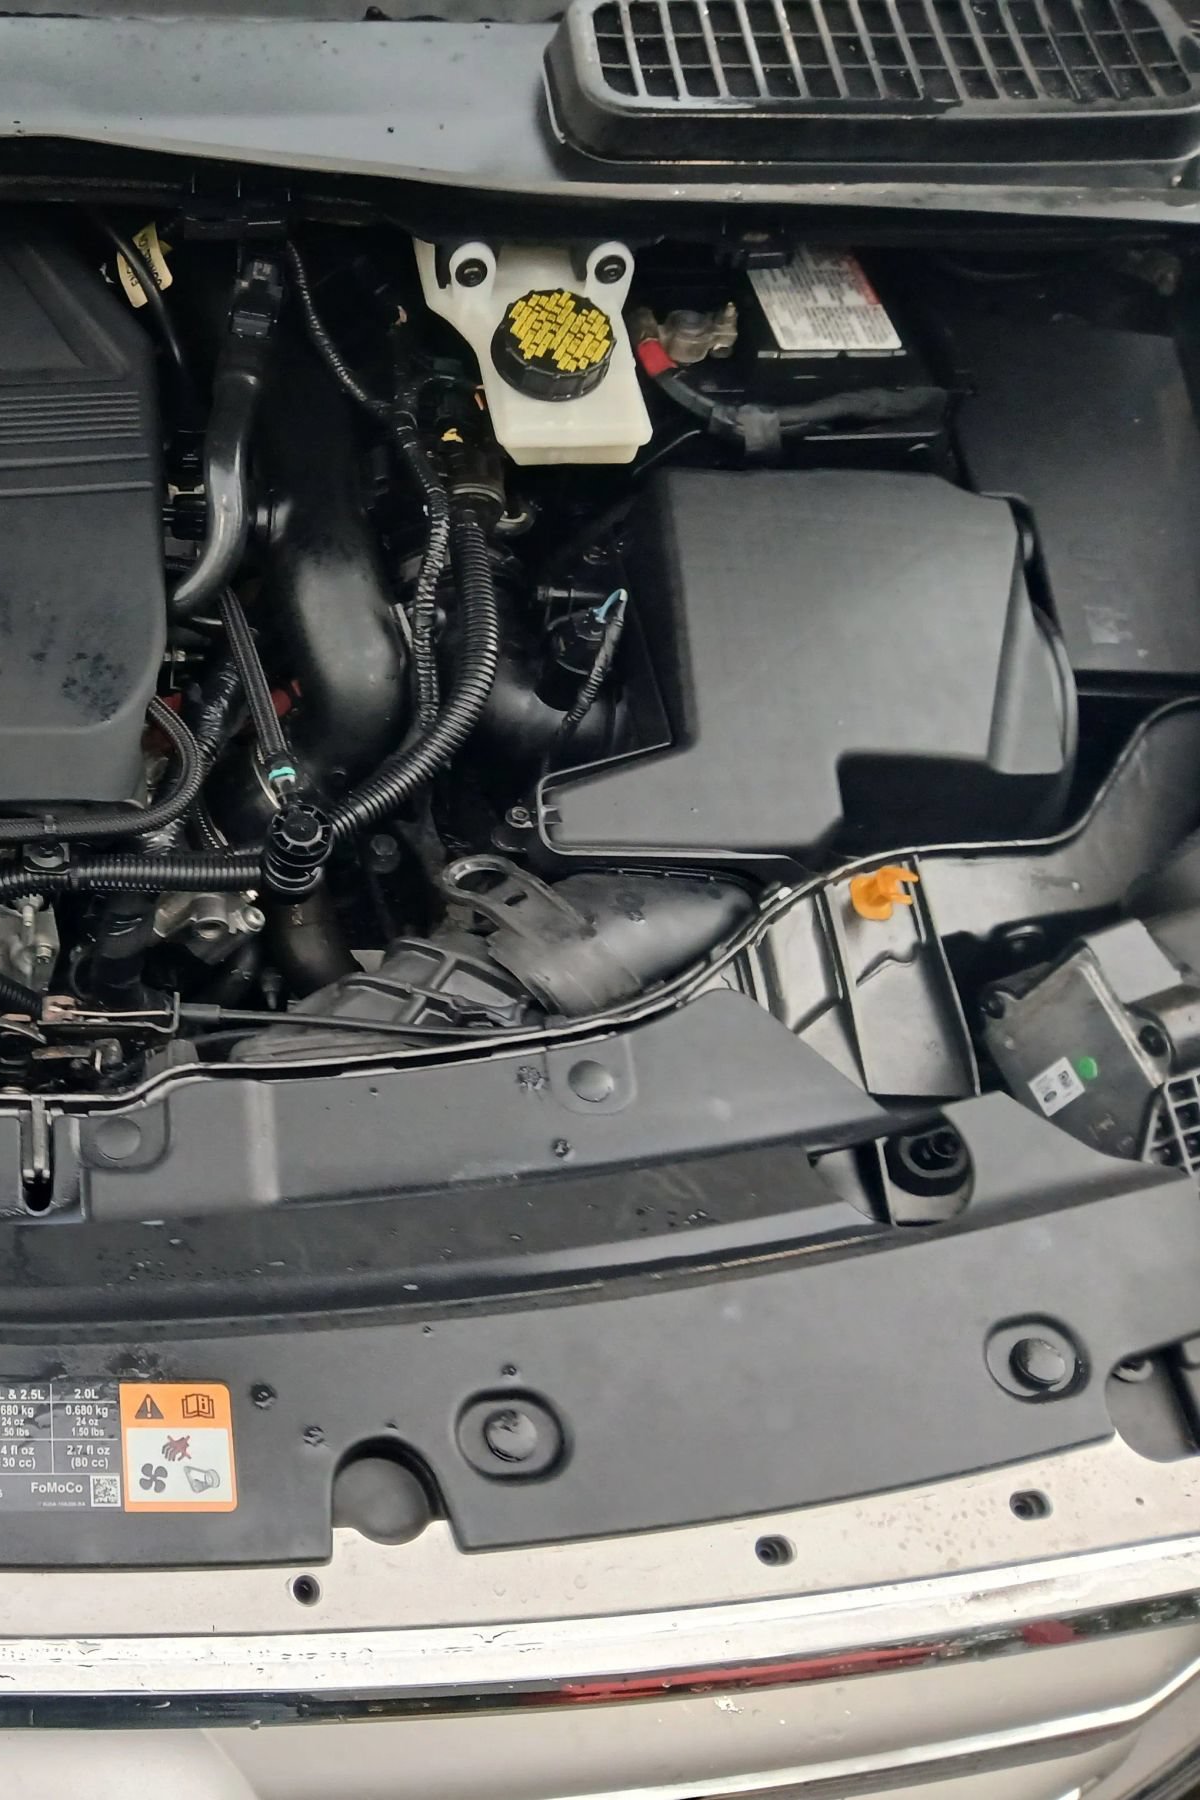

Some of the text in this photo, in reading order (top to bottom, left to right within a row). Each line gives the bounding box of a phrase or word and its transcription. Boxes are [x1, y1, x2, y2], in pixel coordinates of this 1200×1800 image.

[8, 1389, 17, 1400] &
[20, 1389, 45, 1400] 2.5L
[74, 1389, 99, 1399] 2.0L
[21, 1405, 34, 1418] kg
[65, 1405, 108, 1418] 0.680 kg
[1, 1417, 12, 1426] 24
[76, 1417, 86, 1426] 24
[16, 1427, 29, 1436] lbs
[71, 1427, 104, 1436] 1.50 lbs
[11, 1445, 18, 1455] fl
[21, 1447, 35, 1455] oz
[66, 1445, 110, 1455] 2.7 fl oz
[19, 1457, 36, 1469] cc)
[71, 1457, 109, 1469] (80 cc)
[31, 1482, 83, 1493] FoMoCo
